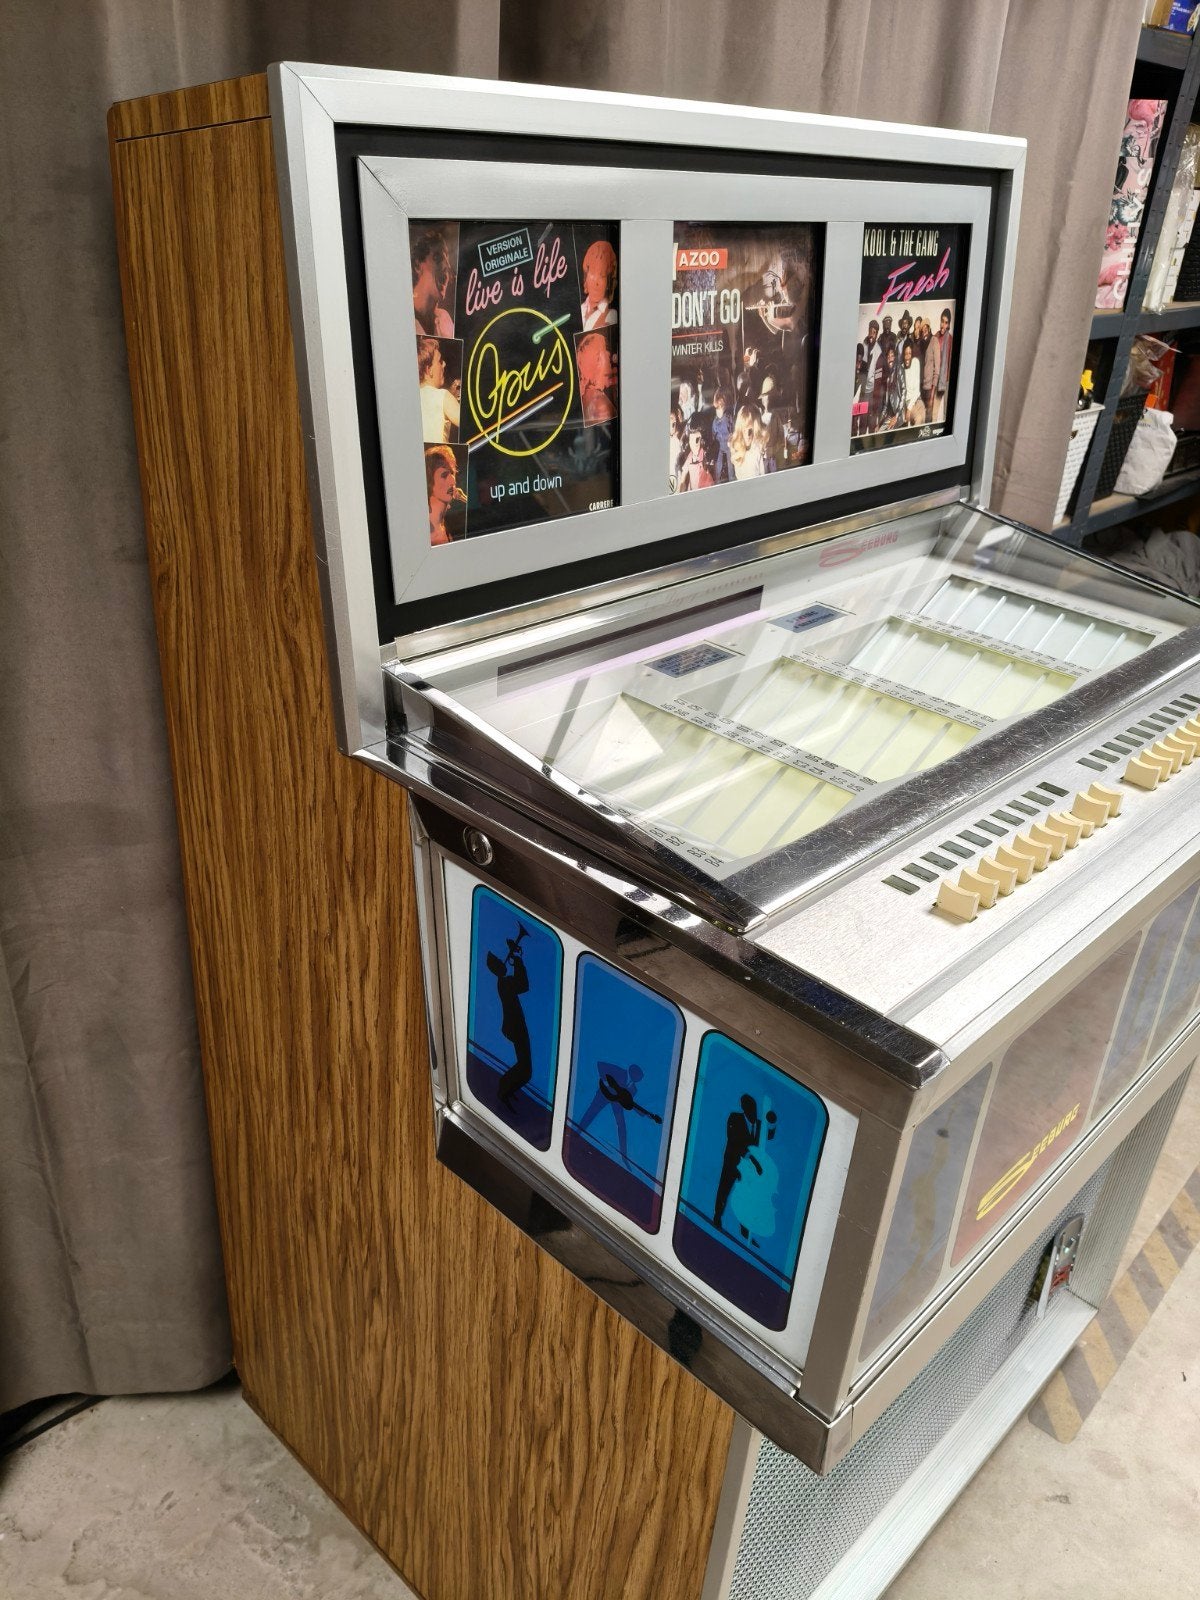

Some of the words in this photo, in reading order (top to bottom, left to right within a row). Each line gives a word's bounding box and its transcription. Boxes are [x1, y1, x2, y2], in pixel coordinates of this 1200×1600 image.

[485, 235, 523, 257] VERSION
[863, 228, 887, 257] KOOL
[889, 229, 897, 257] &
[898, 229, 915, 257] THE
[915, 229, 940, 257] GANG
[484, 247, 530, 272] ORIGINALE
[465, 267, 504, 316] live
[511, 267, 525, 297] is
[533, 236, 569, 299] life
[876, 246, 952, 316] Fresh
[671, 290, 718, 329] DON'T
[719, 288, 741, 325] GO
[671, 343, 703, 357] WINTER
[704, 339, 725, 353] KILLS
[490, 484, 505, 502] up
[508, 475, 530, 496] and
[533, 473, 563, 492] down
[976, 1102, 1081, 1221] SEEBURG
